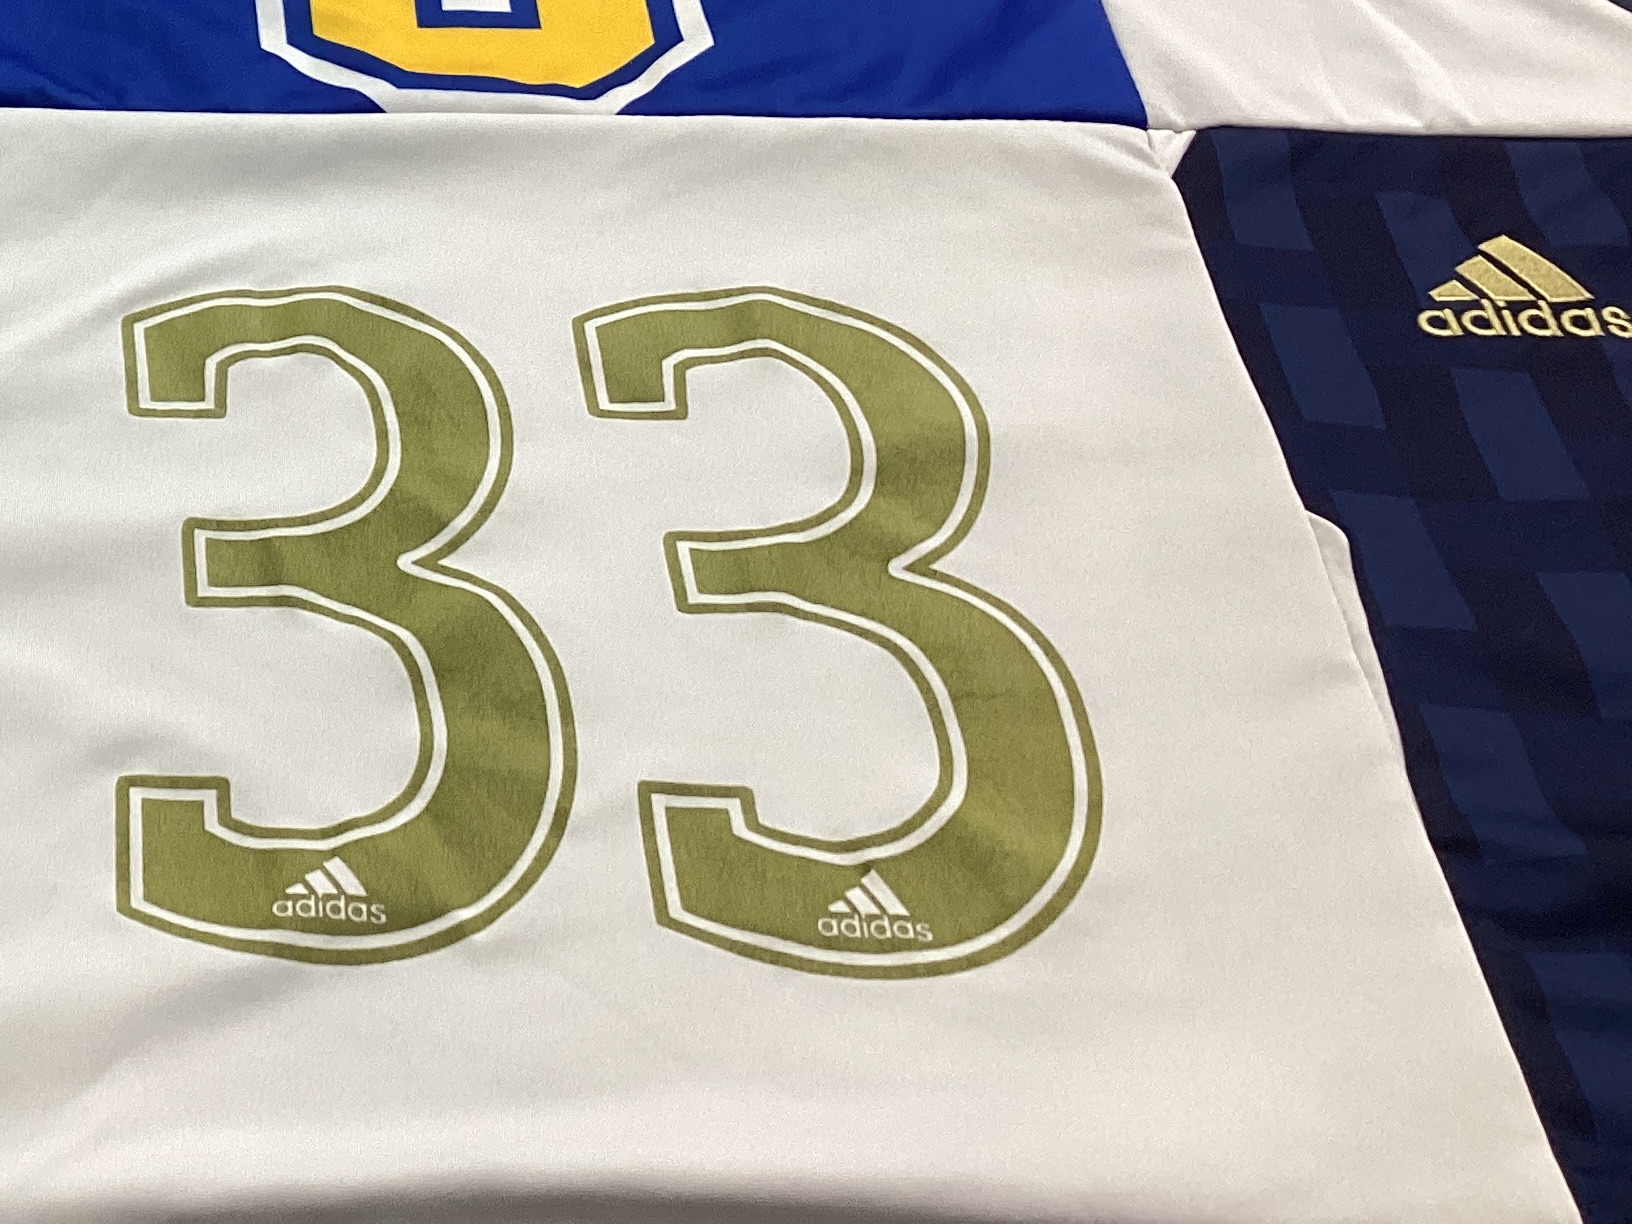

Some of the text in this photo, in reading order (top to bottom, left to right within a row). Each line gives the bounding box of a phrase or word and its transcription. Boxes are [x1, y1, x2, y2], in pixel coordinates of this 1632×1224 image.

[1417, 298, 1632, 339] adidas
[115, 285, 1103, 980] 33
[271, 893, 387, 925] adidas
[817, 913, 934, 943] adidas
